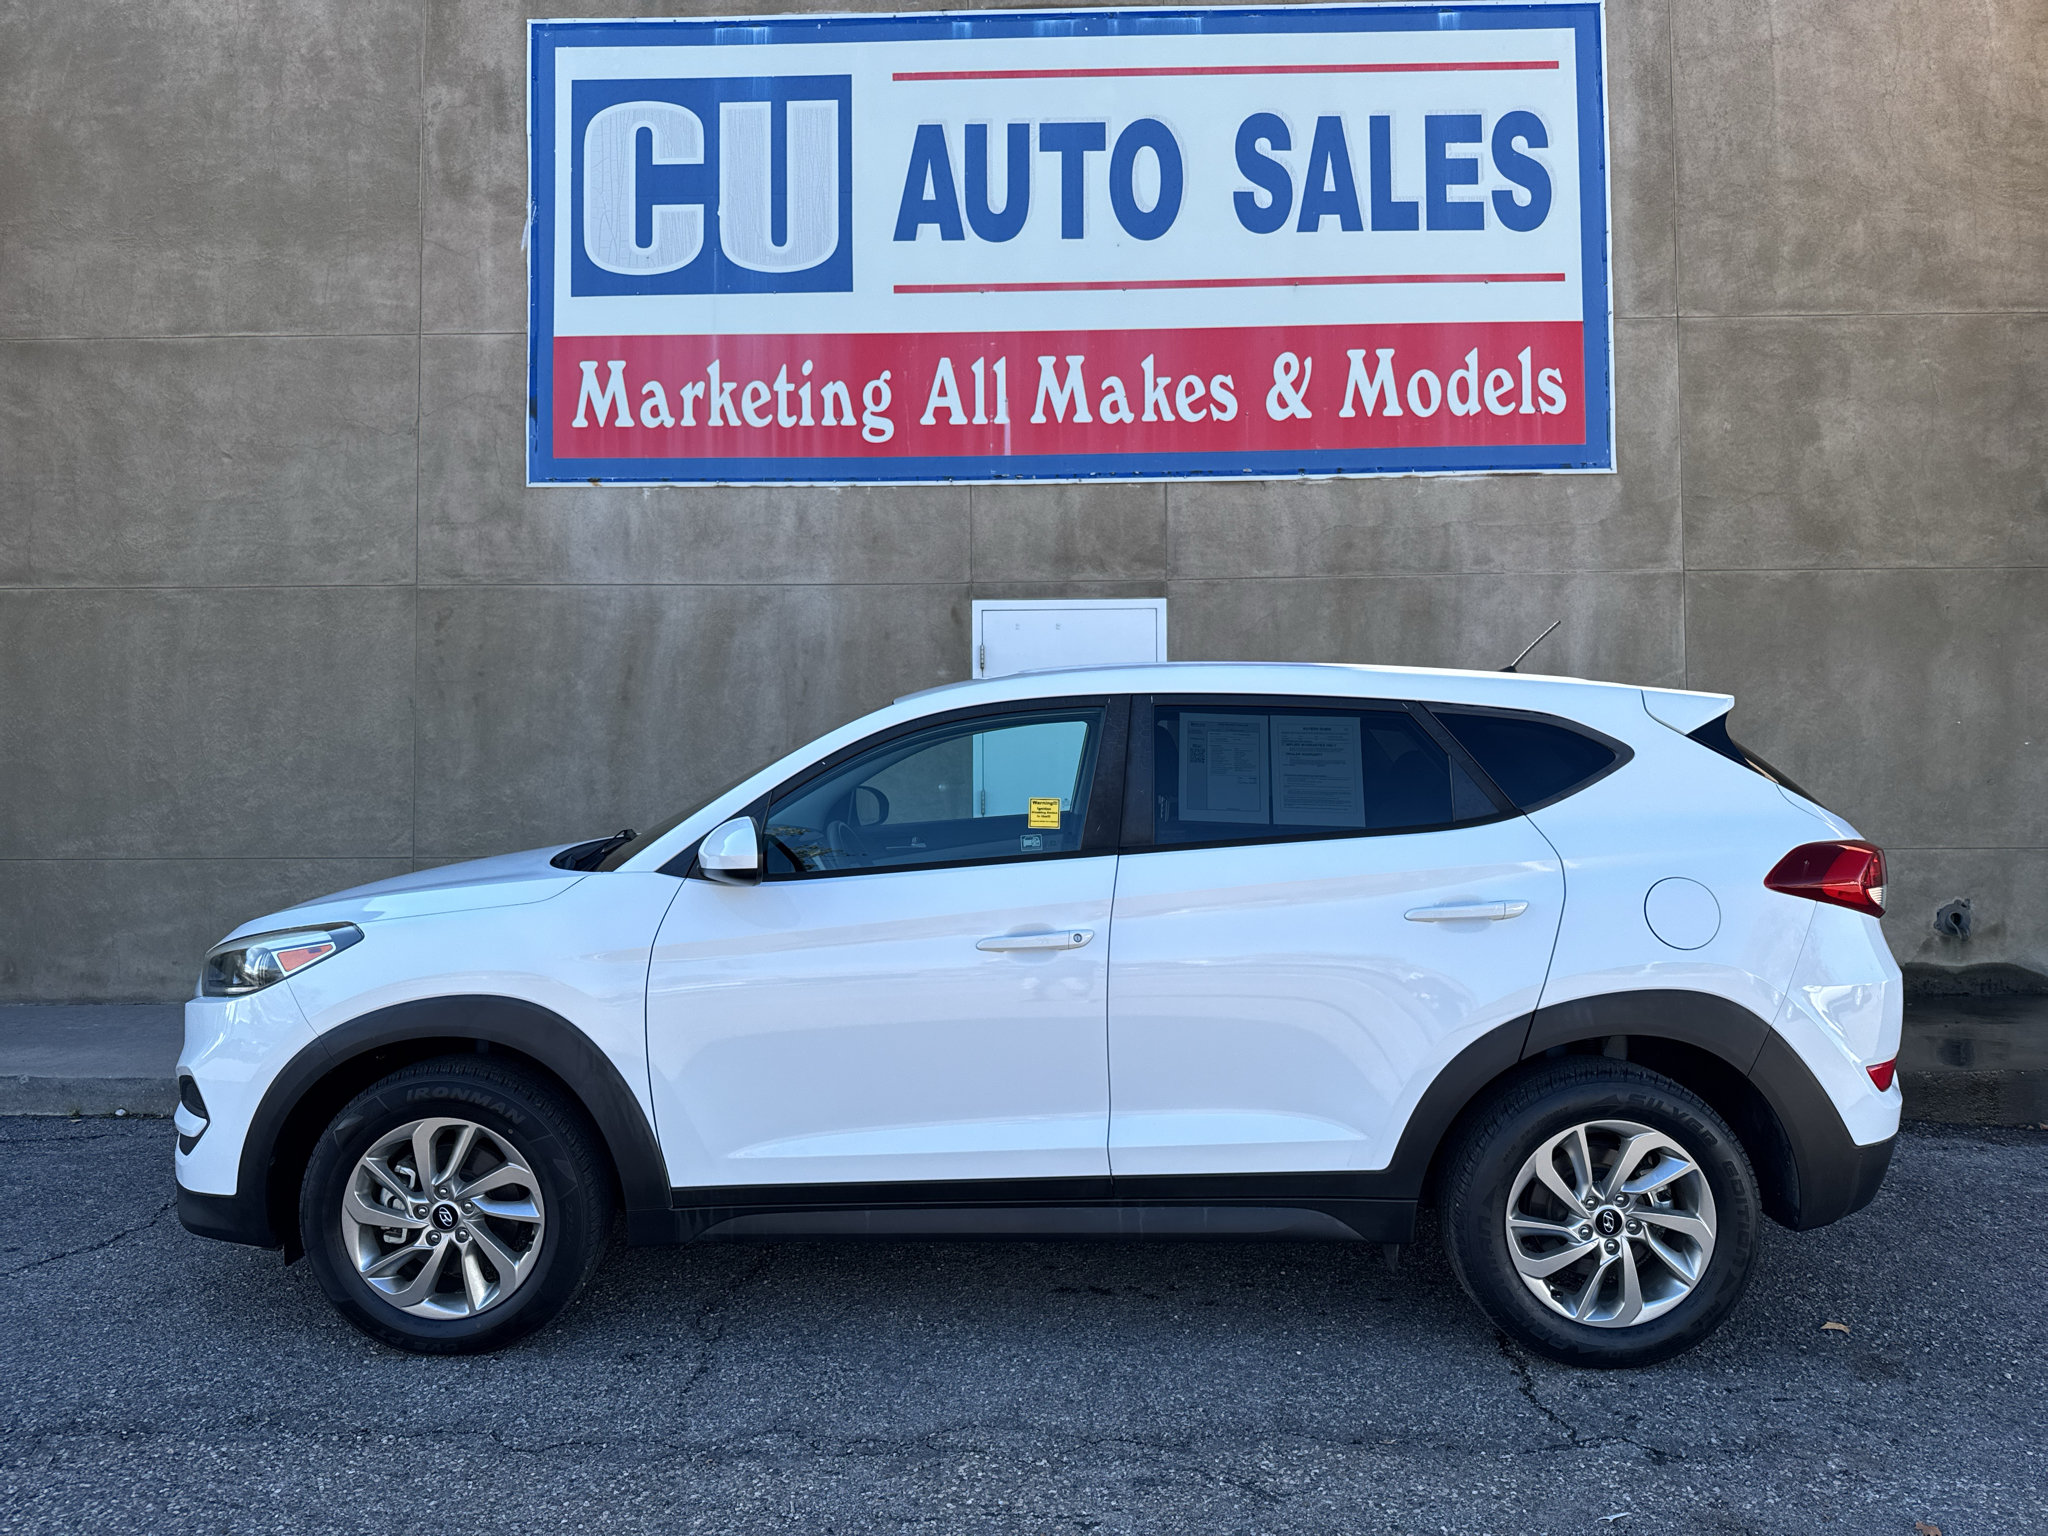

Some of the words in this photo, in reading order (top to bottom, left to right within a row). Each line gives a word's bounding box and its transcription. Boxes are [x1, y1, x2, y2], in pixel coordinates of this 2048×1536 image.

[583, 99, 840, 276] CU
[892, 117, 1187, 243] AUTO
[1232, 110, 1555, 235] SALES
[571, 359, 895, 443] Marketing
[919, 356, 1011, 426] All
[1030, 354, 1238, 425] Makes
[1265, 351, 1313, 421] &
[1338, 346, 1567, 418] Models
[406, 1086, 527, 1124] IRONMAN
[1627, 1093, 1719, 1146] SILVER
